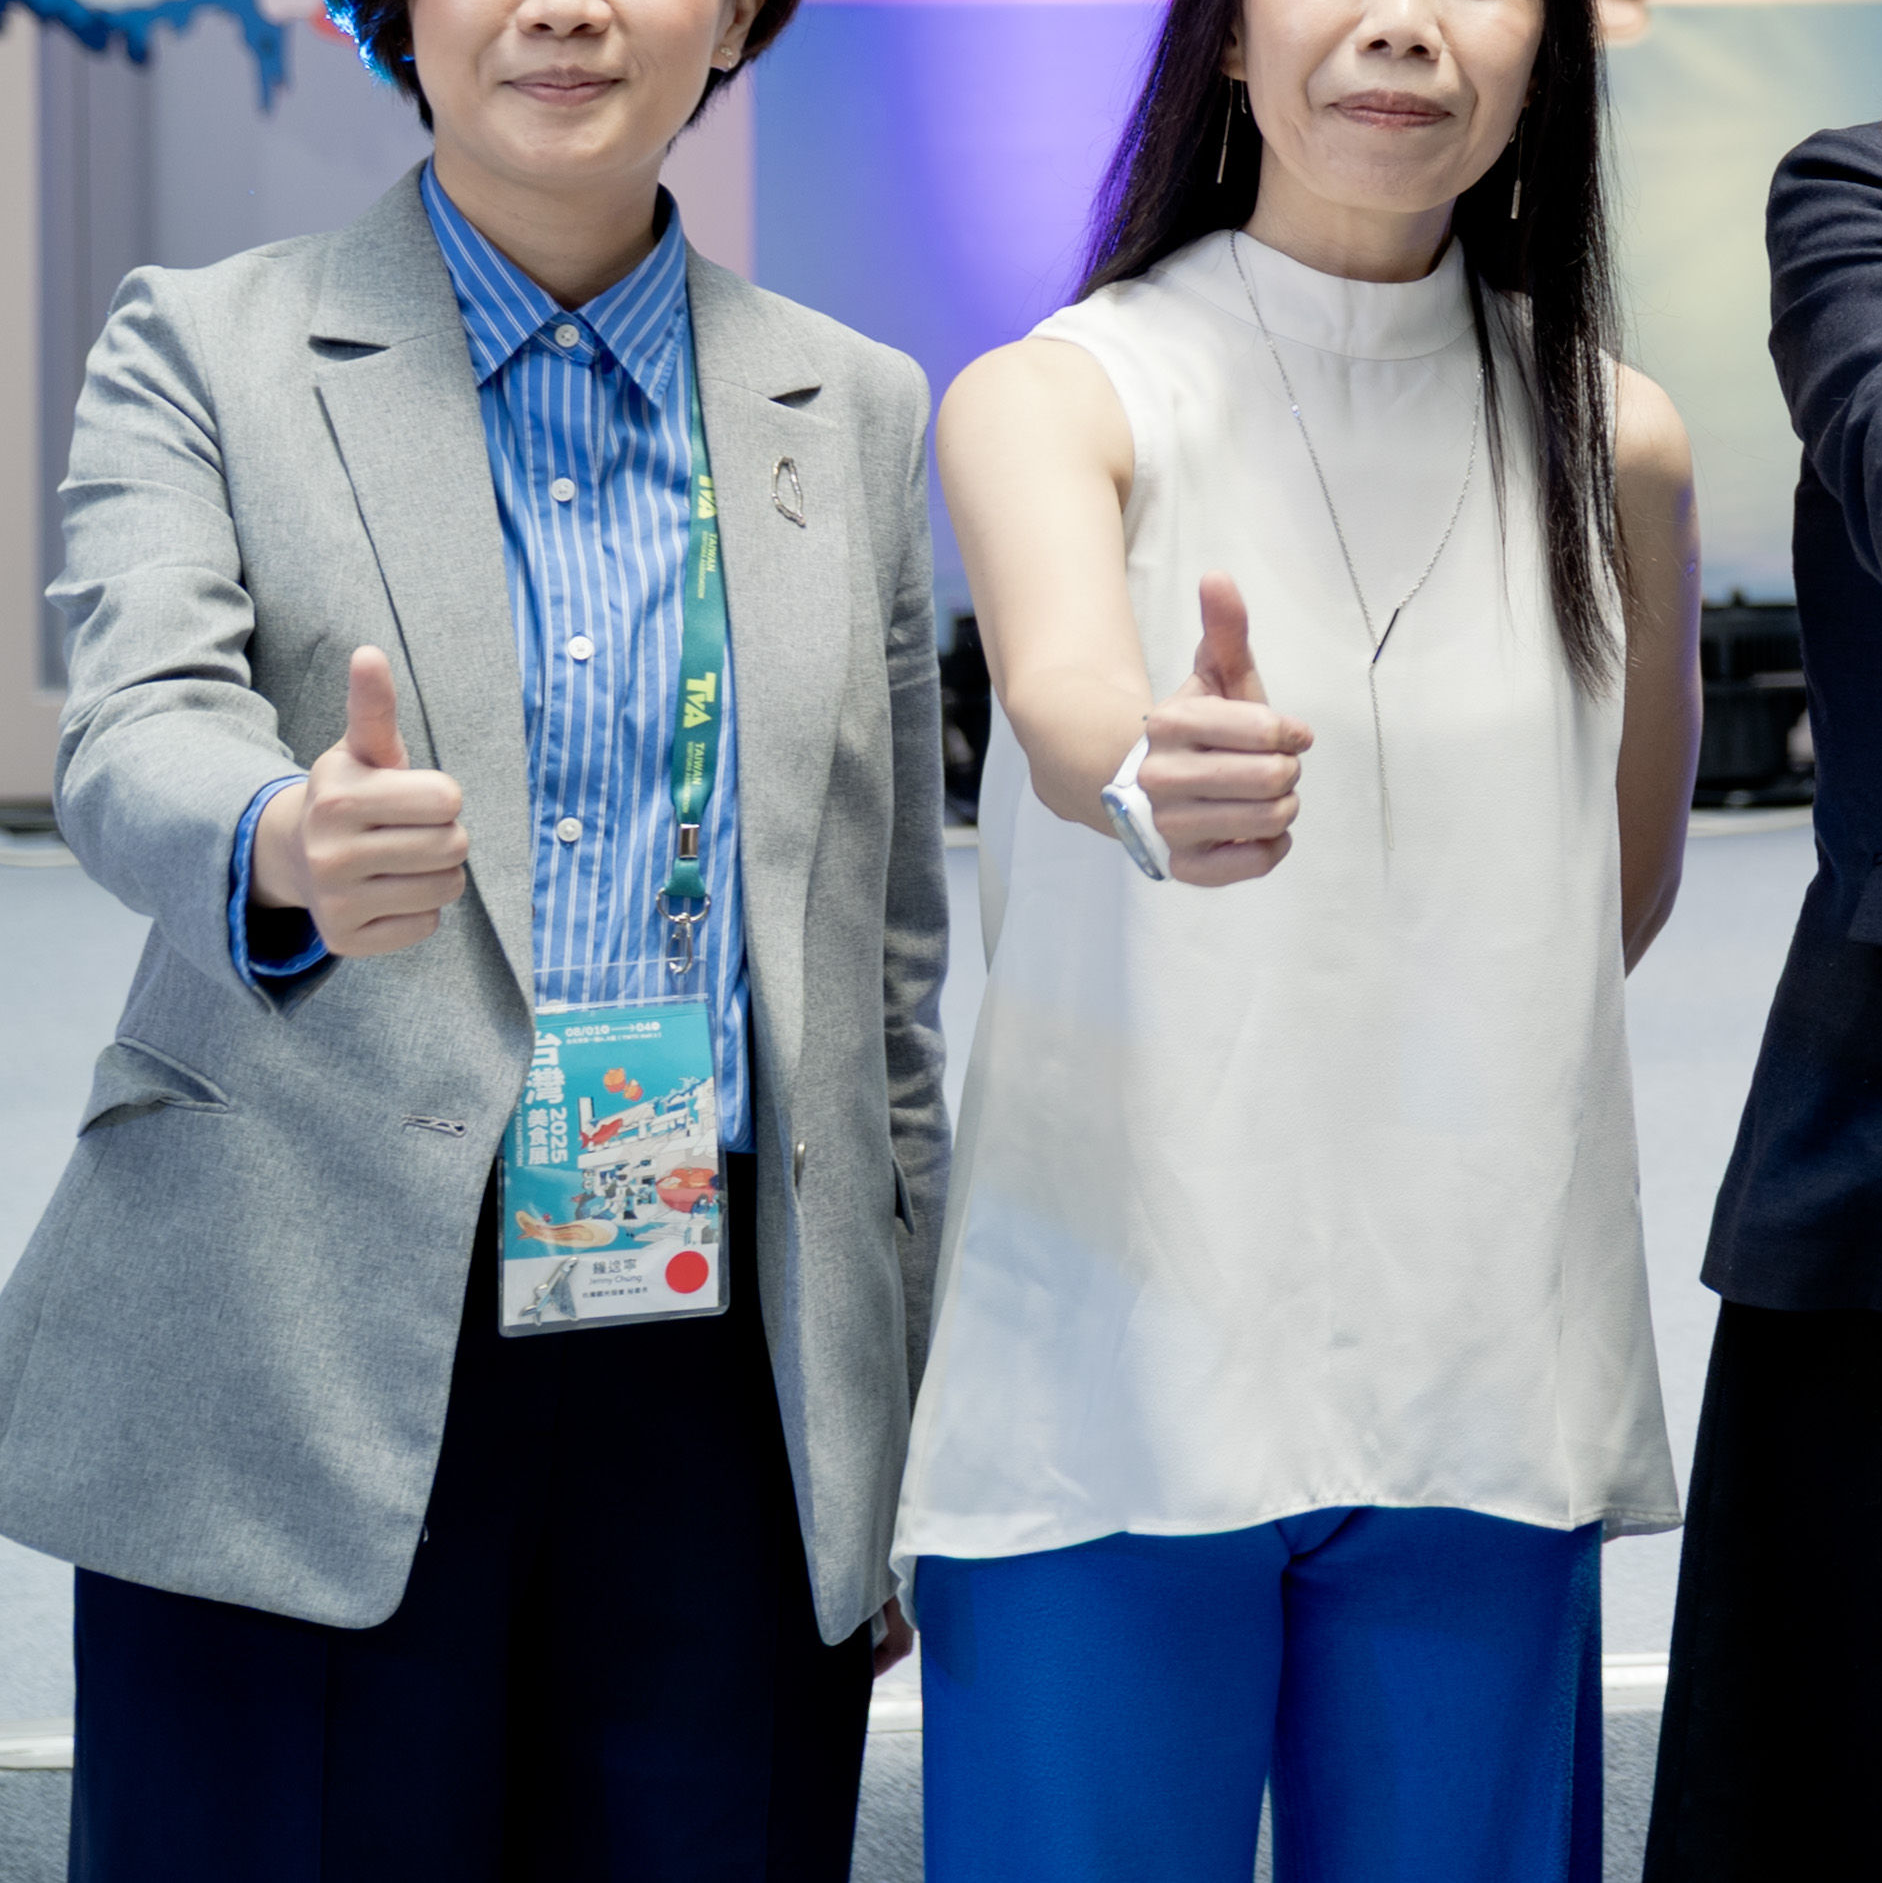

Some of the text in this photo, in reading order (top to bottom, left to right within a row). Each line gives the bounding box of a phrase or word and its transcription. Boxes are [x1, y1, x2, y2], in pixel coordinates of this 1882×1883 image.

[706, 533, 718, 572] TAIWAN
[692, 742, 705, 785] TAIWAN
[550, 1107, 568, 1164] 2025
